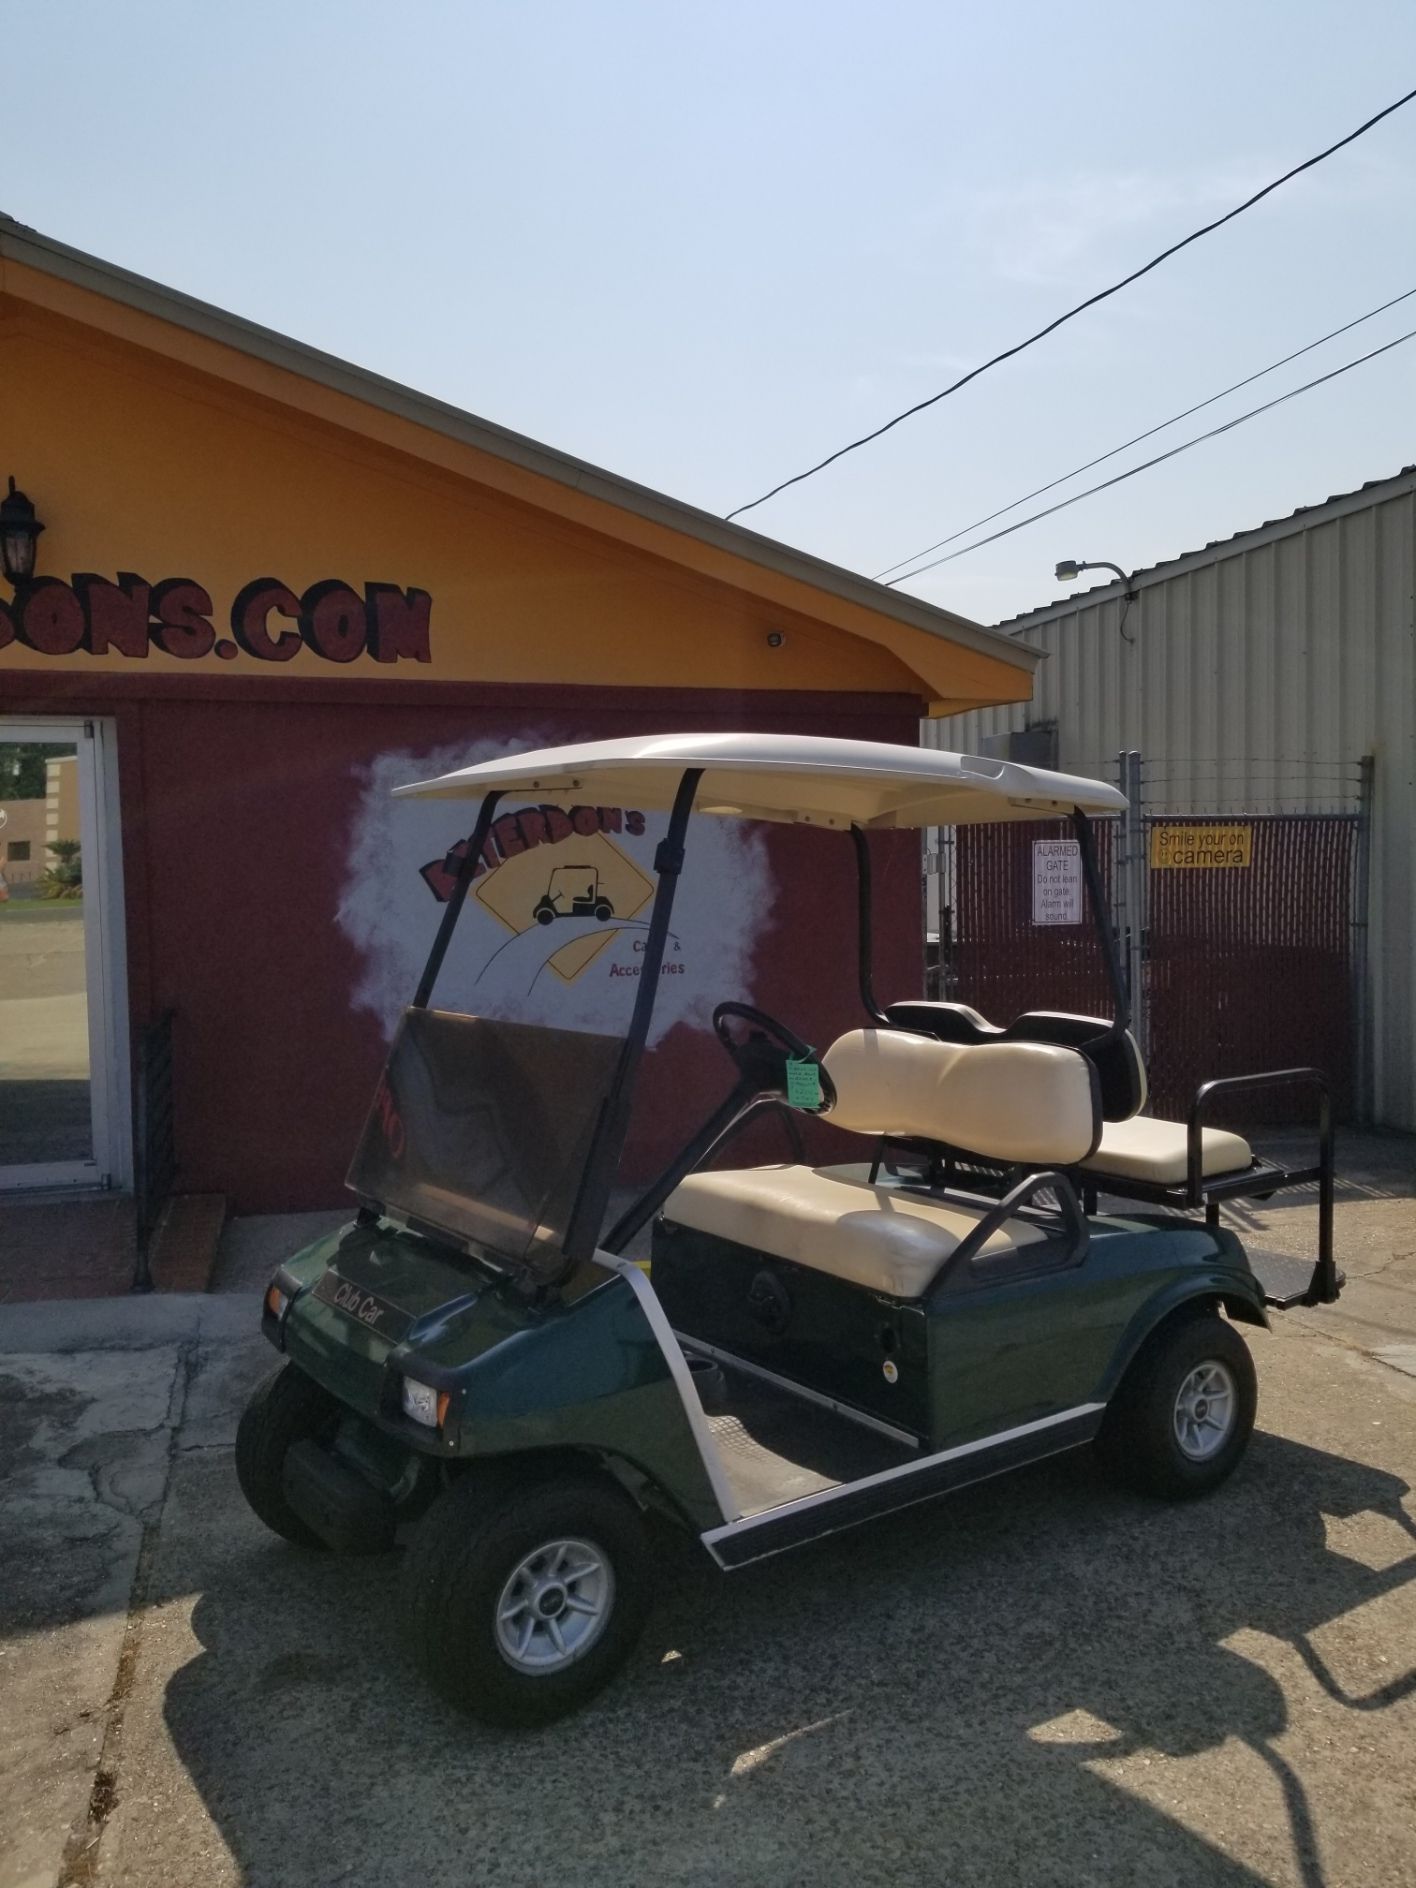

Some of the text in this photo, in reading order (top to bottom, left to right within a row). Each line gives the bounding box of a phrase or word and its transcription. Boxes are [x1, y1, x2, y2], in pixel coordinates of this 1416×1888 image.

[0, 572, 432, 663] ONS.COM
[1160, 831, 1244, 849] Smile your on
[1037, 845, 1078, 857] ALARMED
[1173, 849, 1243, 864] camera
[1046, 860, 1069, 870] GATE
[1037, 874, 1048, 884] Do
[1049, 875, 1061, 884] not
[1043, 888, 1053, 896] on
[609, 962, 685, 977] Acceries
[334, 1283, 384, 1324] Club Car
